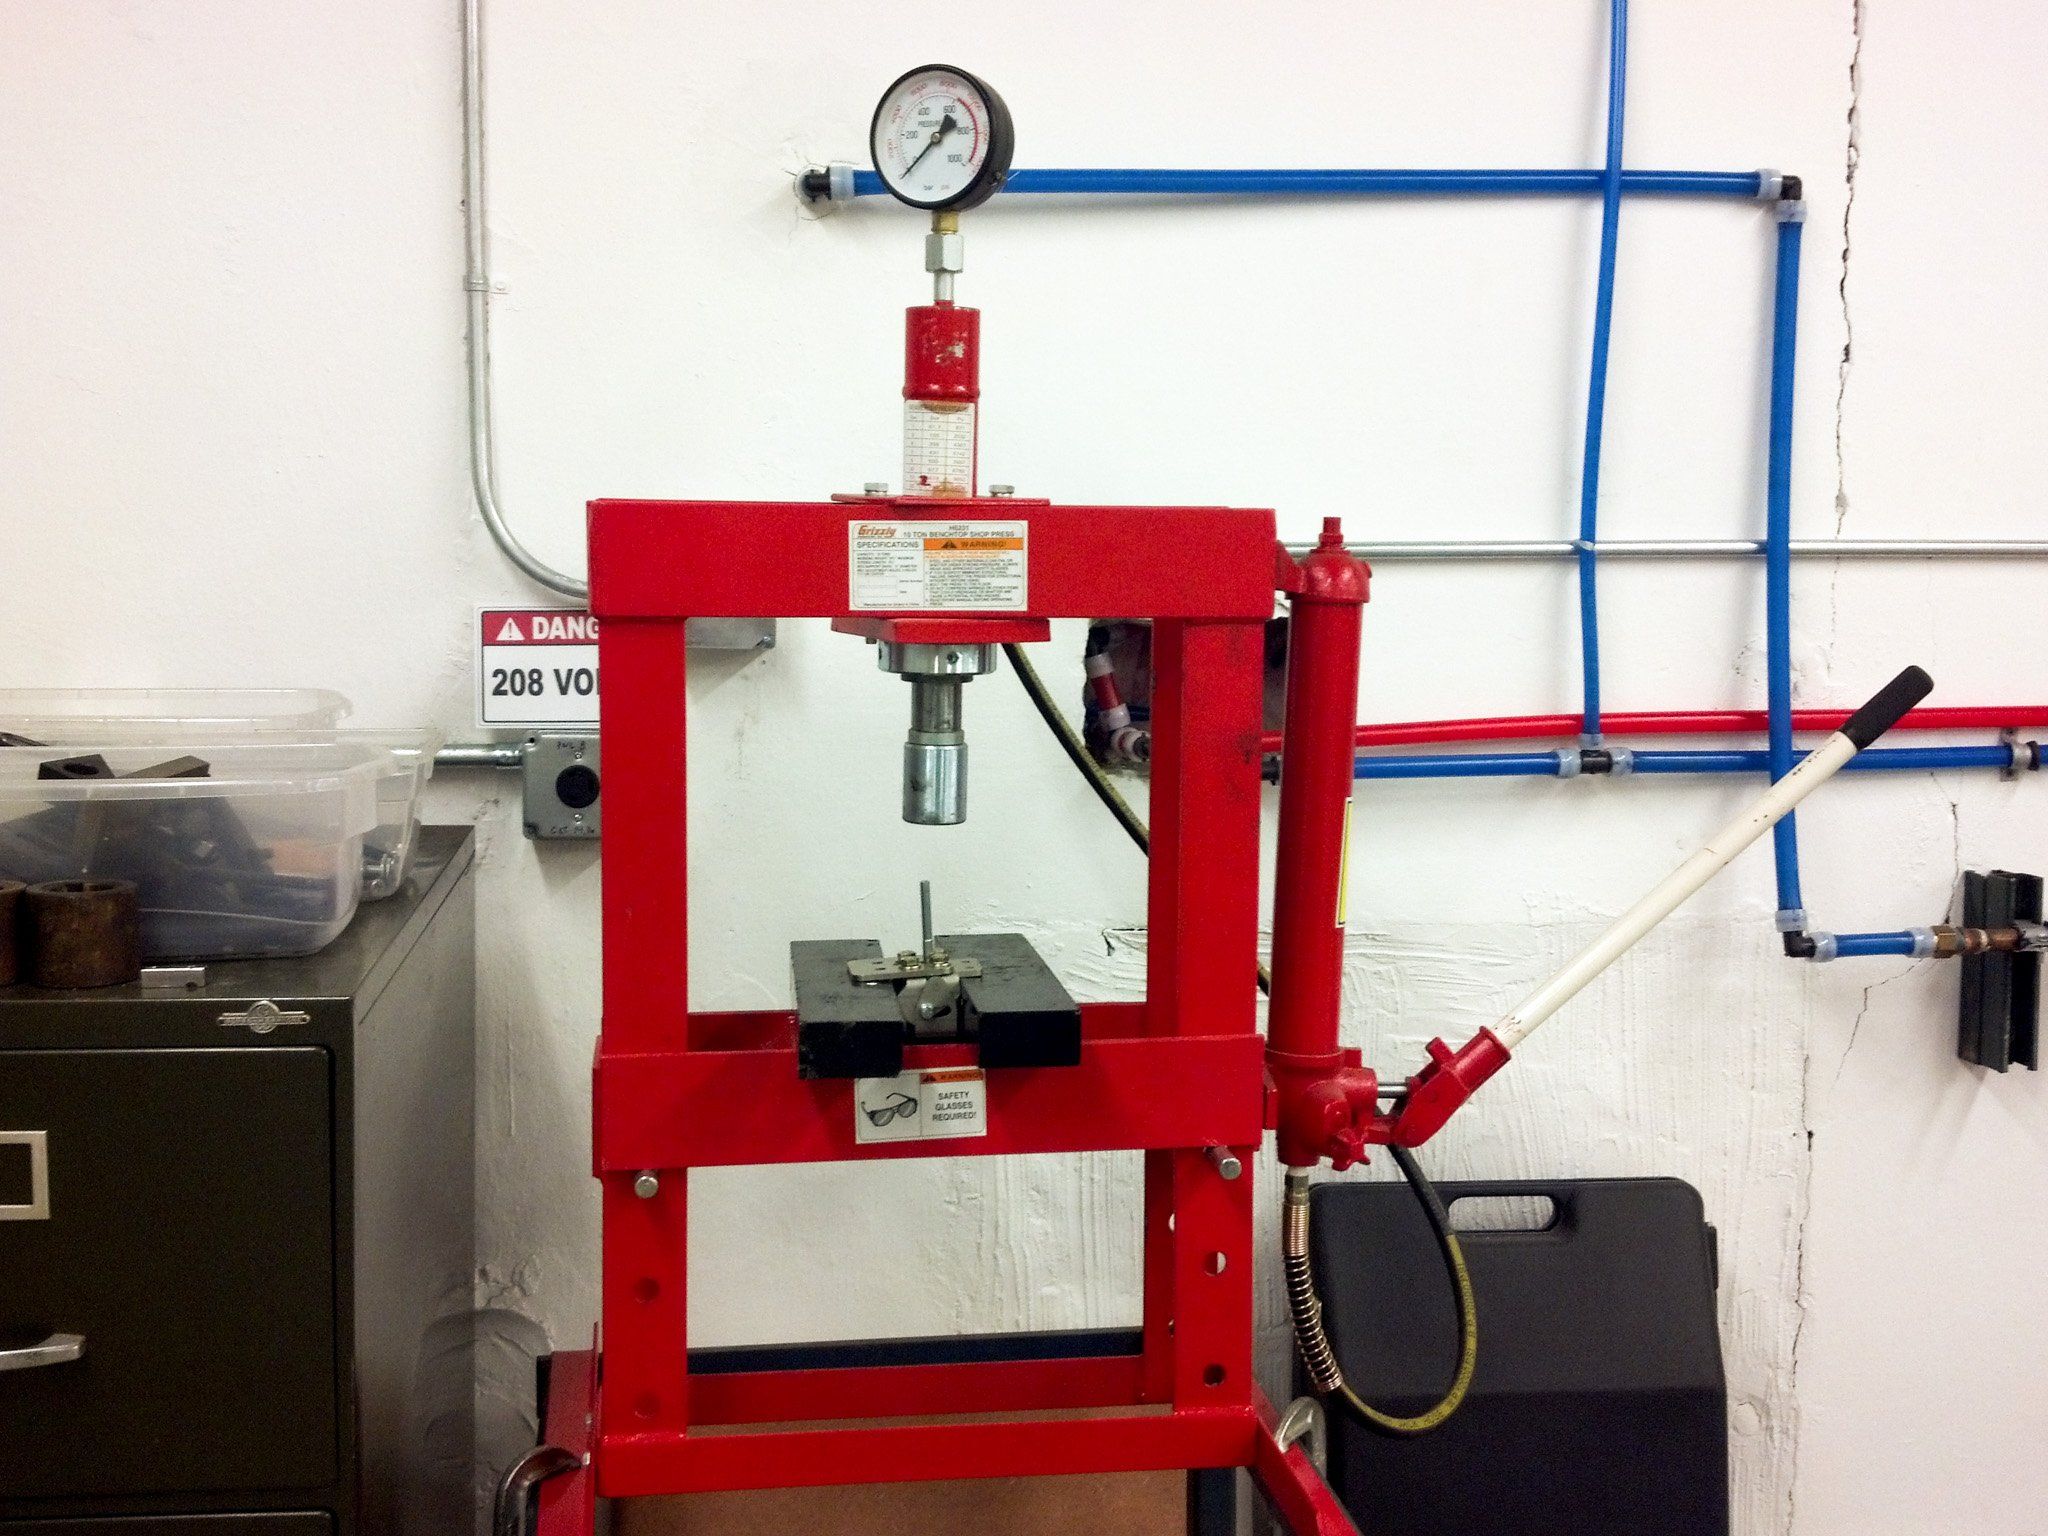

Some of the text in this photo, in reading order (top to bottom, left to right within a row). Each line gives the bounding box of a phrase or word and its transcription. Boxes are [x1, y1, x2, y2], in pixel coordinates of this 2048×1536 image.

[906, 130, 918, 139] 200
[858, 524, 897, 538] Grizzly
[857, 541, 919, 549] SPECIFICATIONS
[492, 668, 599, 696] 208 VO
[938, 1091, 969, 1100] SAFETY
[935, 1101, 973, 1111] GLASSES
[932, 1111, 977, 1121] REQUIRED!
